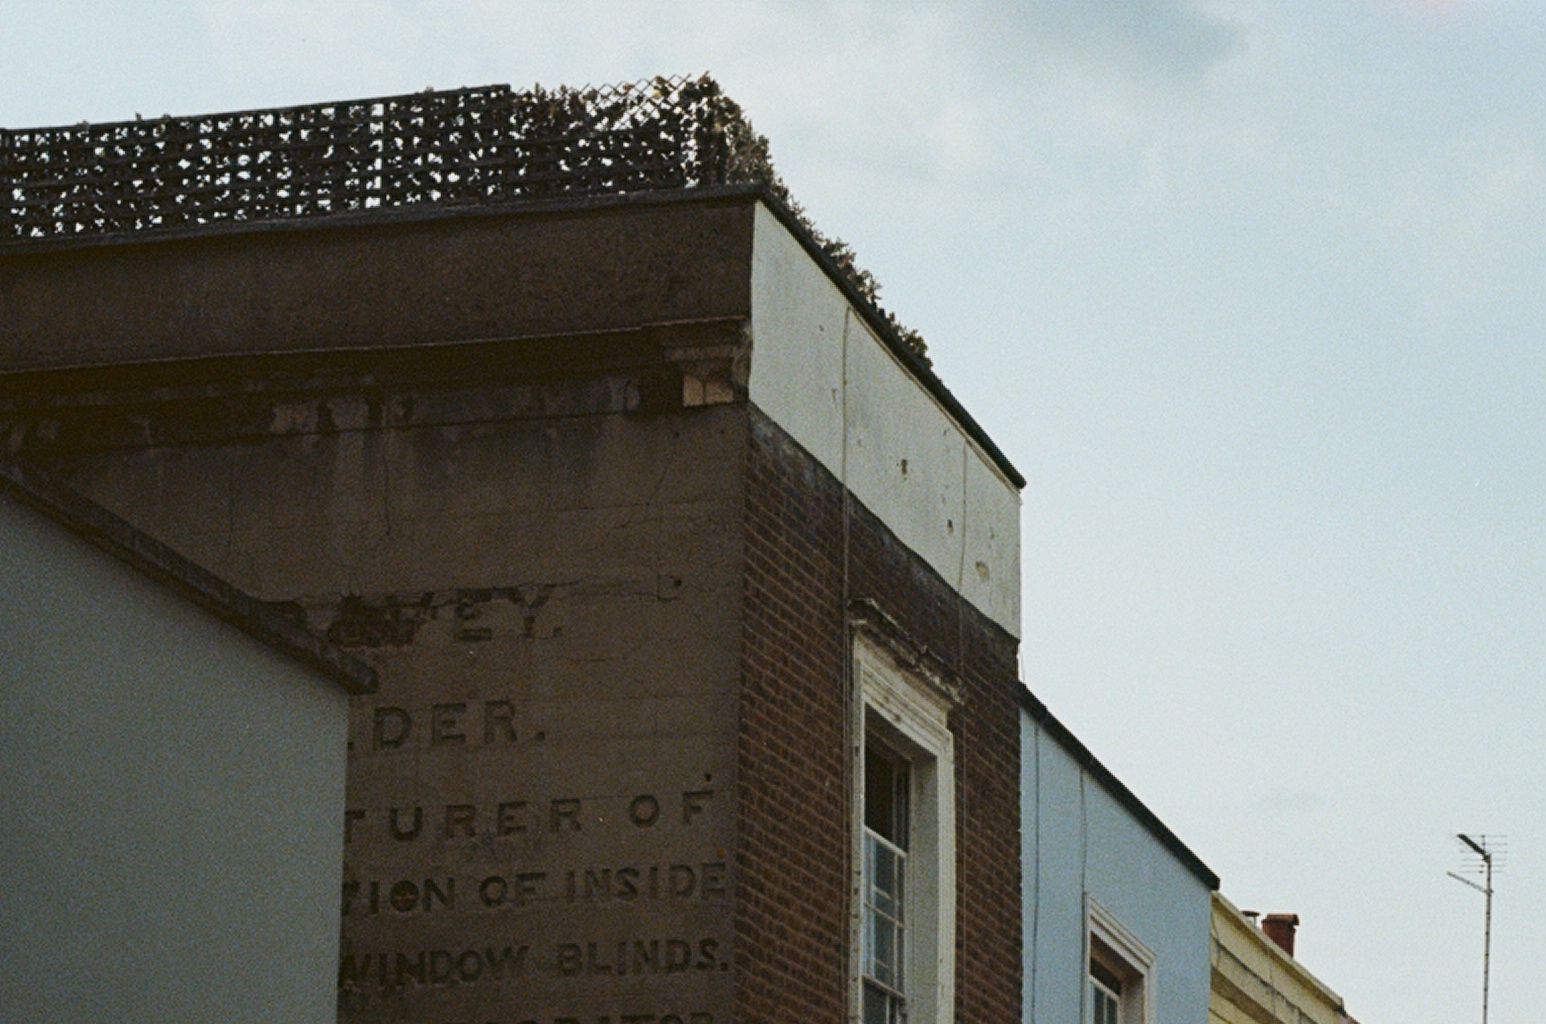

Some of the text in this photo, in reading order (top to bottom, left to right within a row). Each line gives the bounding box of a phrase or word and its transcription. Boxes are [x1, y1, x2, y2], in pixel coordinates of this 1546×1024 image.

[629, 789, 714, 829] OF
[479, 872, 546, 908] OF
[566, 862, 727, 903] INSIDE
